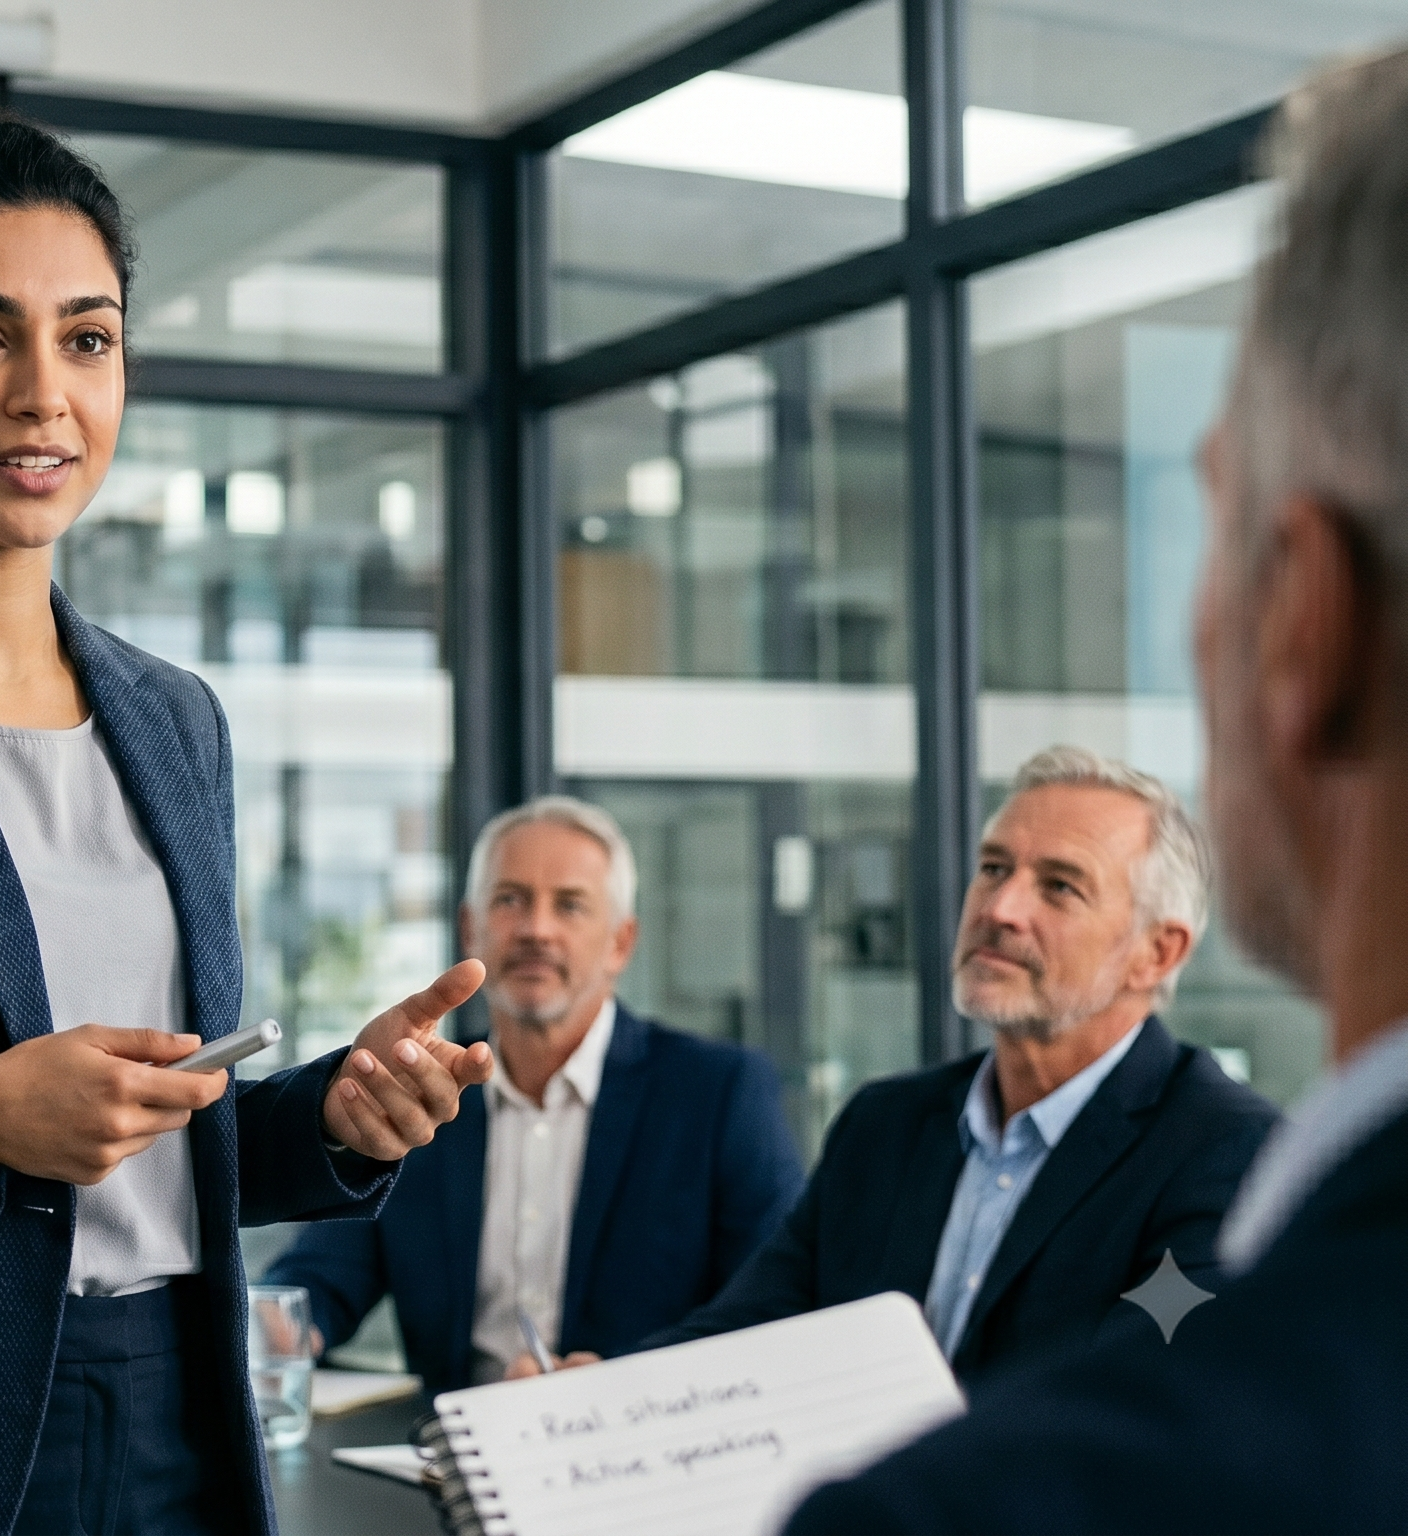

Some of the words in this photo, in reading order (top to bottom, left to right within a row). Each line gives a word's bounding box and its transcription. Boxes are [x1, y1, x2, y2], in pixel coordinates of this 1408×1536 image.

[540, 1407, 605, 1440] Real
[624, 1379, 761, 1424] situations
[569, 1457, 649, 1487] Active
[665, 1428, 783, 1474] speaking
